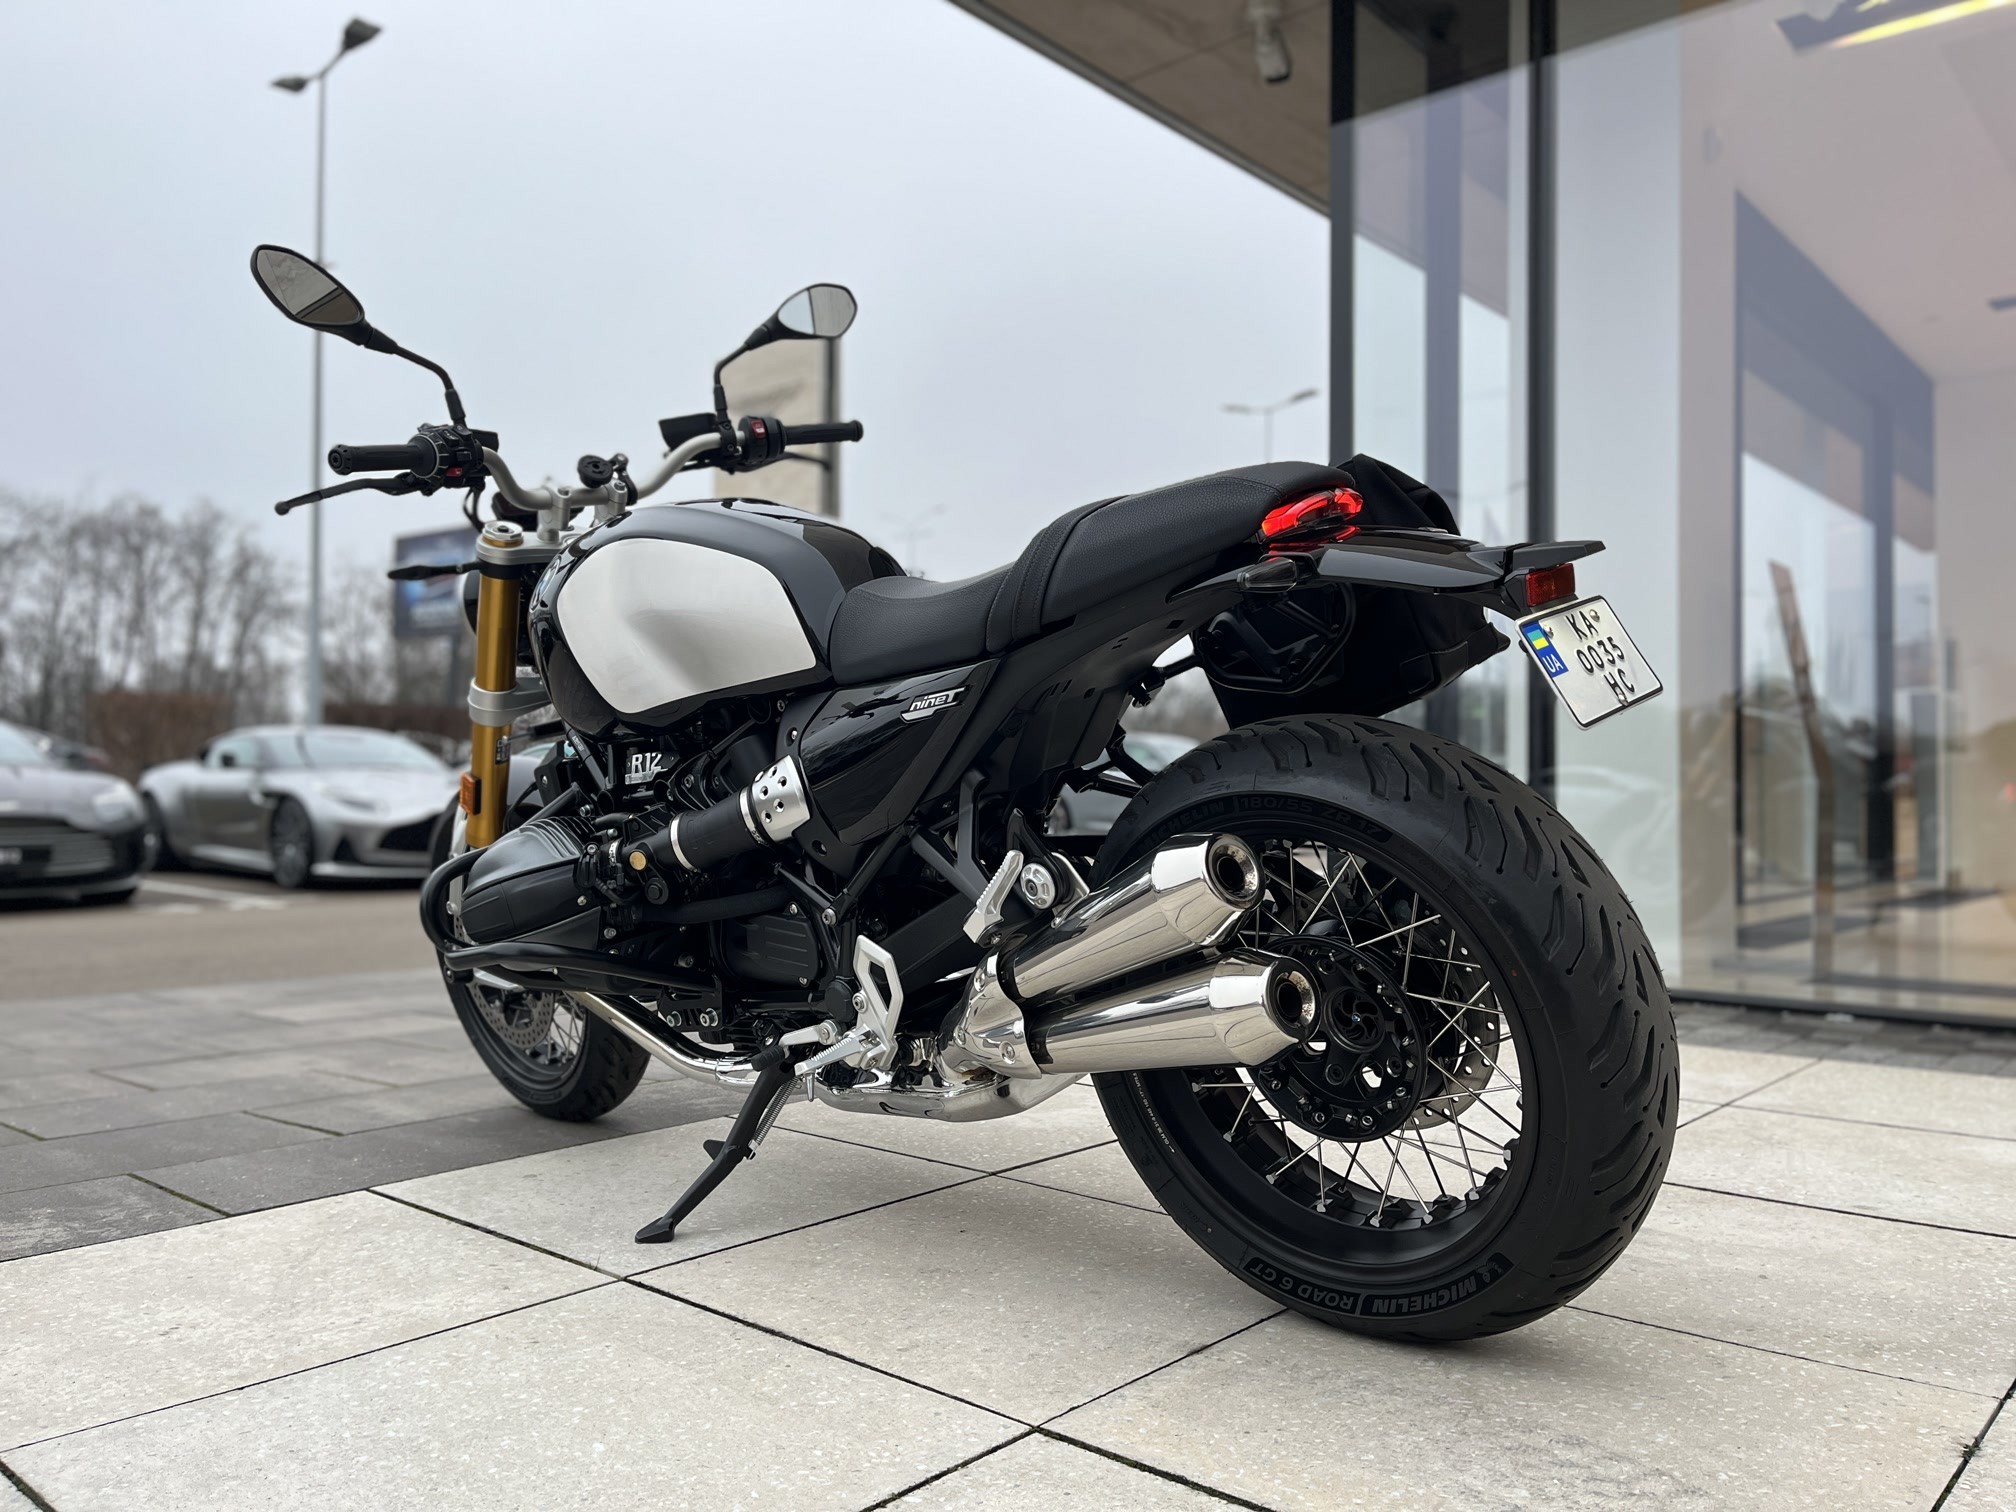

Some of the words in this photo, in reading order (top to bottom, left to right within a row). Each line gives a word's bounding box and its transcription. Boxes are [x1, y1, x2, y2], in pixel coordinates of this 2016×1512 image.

[1565, 610, 1599, 640] KA
[1542, 656, 1564, 673] UA
[1576, 636, 1624, 674] 0035
[909, 686, 967, 711] nineT
[1604, 668, 1635, 705] HC
[631, 752, 663, 774] R12
[1241, 796, 1314, 814] 180/55
[1321, 807, 1352, 824] ZR
[1355, 819, 1383, 837] 17
[1250, 1262, 1278, 1283] GT
[1279, 1277, 1294, 1291] 6
[1297, 1285, 1355, 1310] ROAD
[1371, 1275, 1477, 1314] MICHELIN
